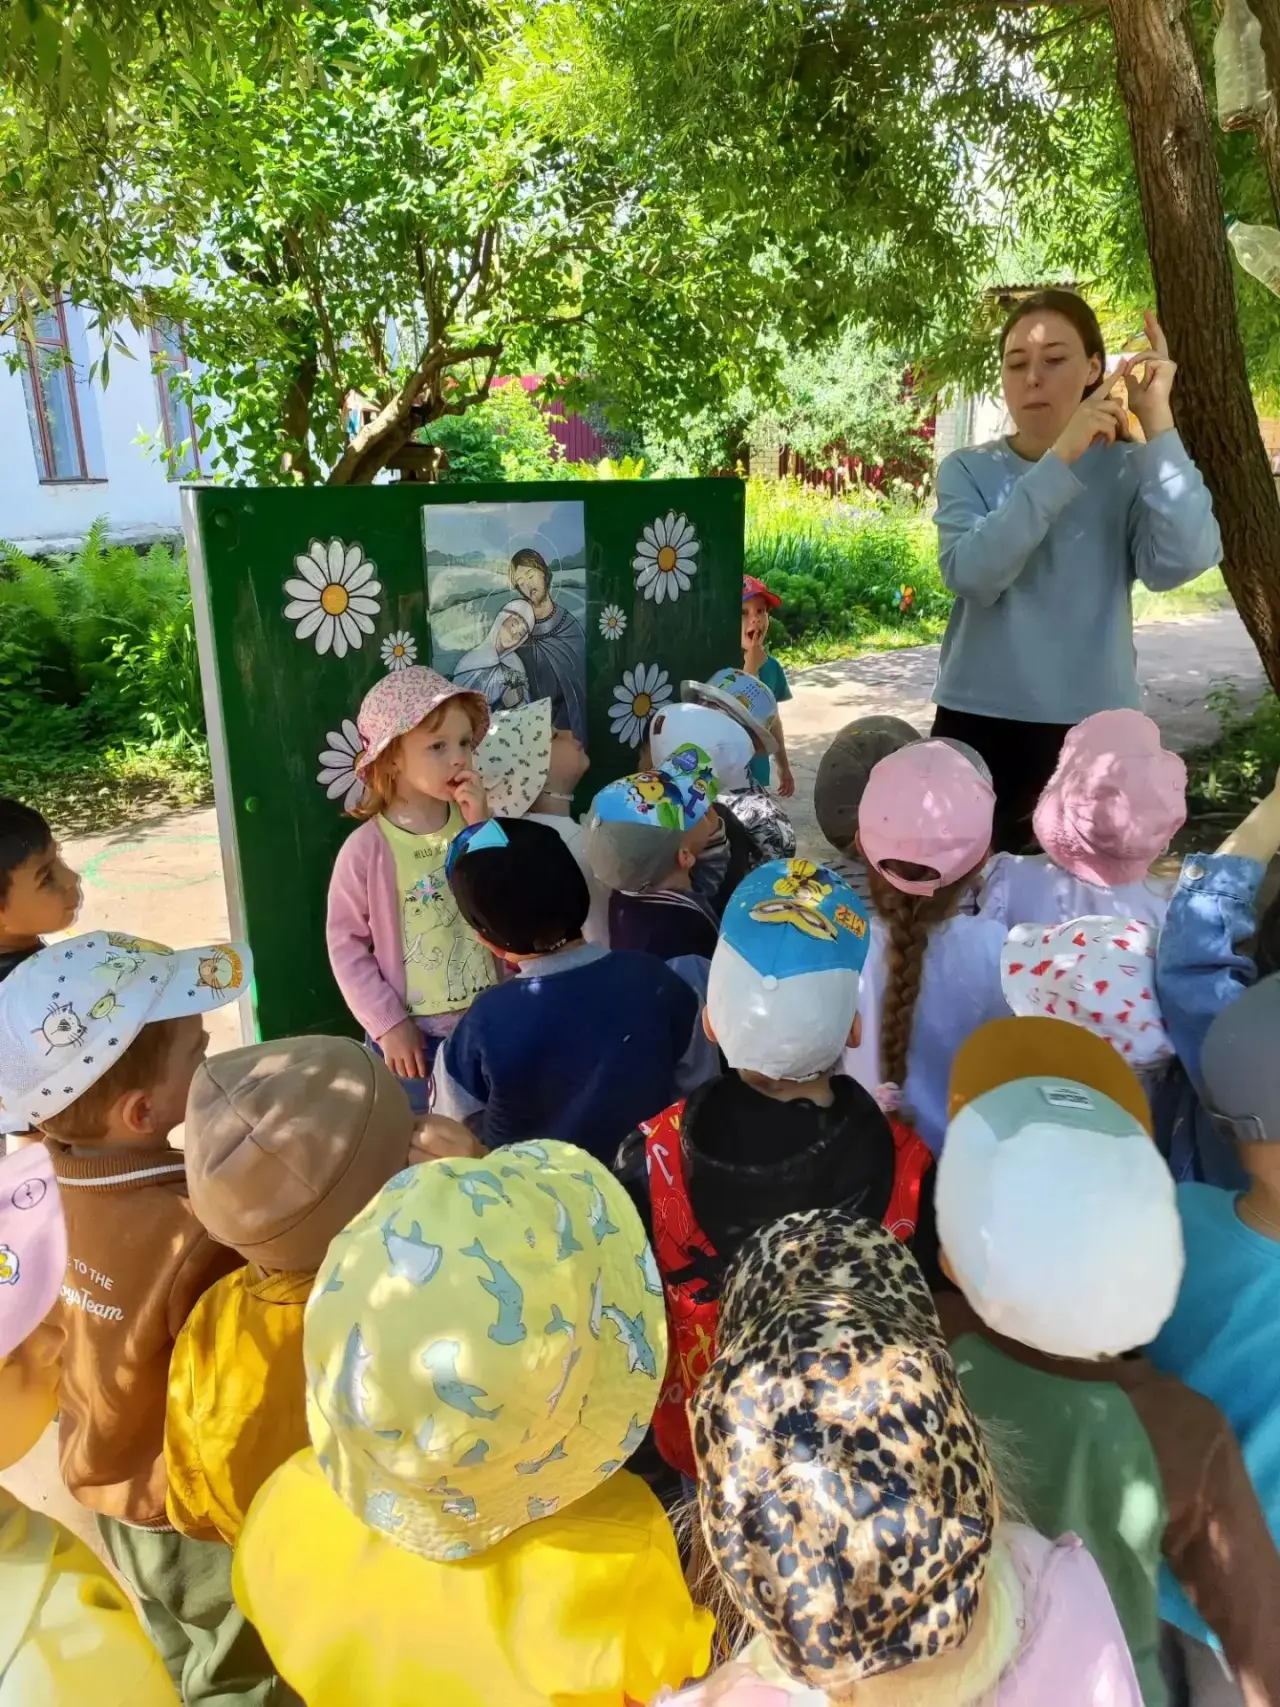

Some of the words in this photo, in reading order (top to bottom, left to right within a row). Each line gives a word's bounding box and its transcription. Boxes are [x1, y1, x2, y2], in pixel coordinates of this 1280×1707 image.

[413, 848, 433, 859] HELLO
[73, 1258, 87, 1275] TO
[90, 1267, 114, 1291] THE
[60, 1285, 124, 1321] oysTeam
